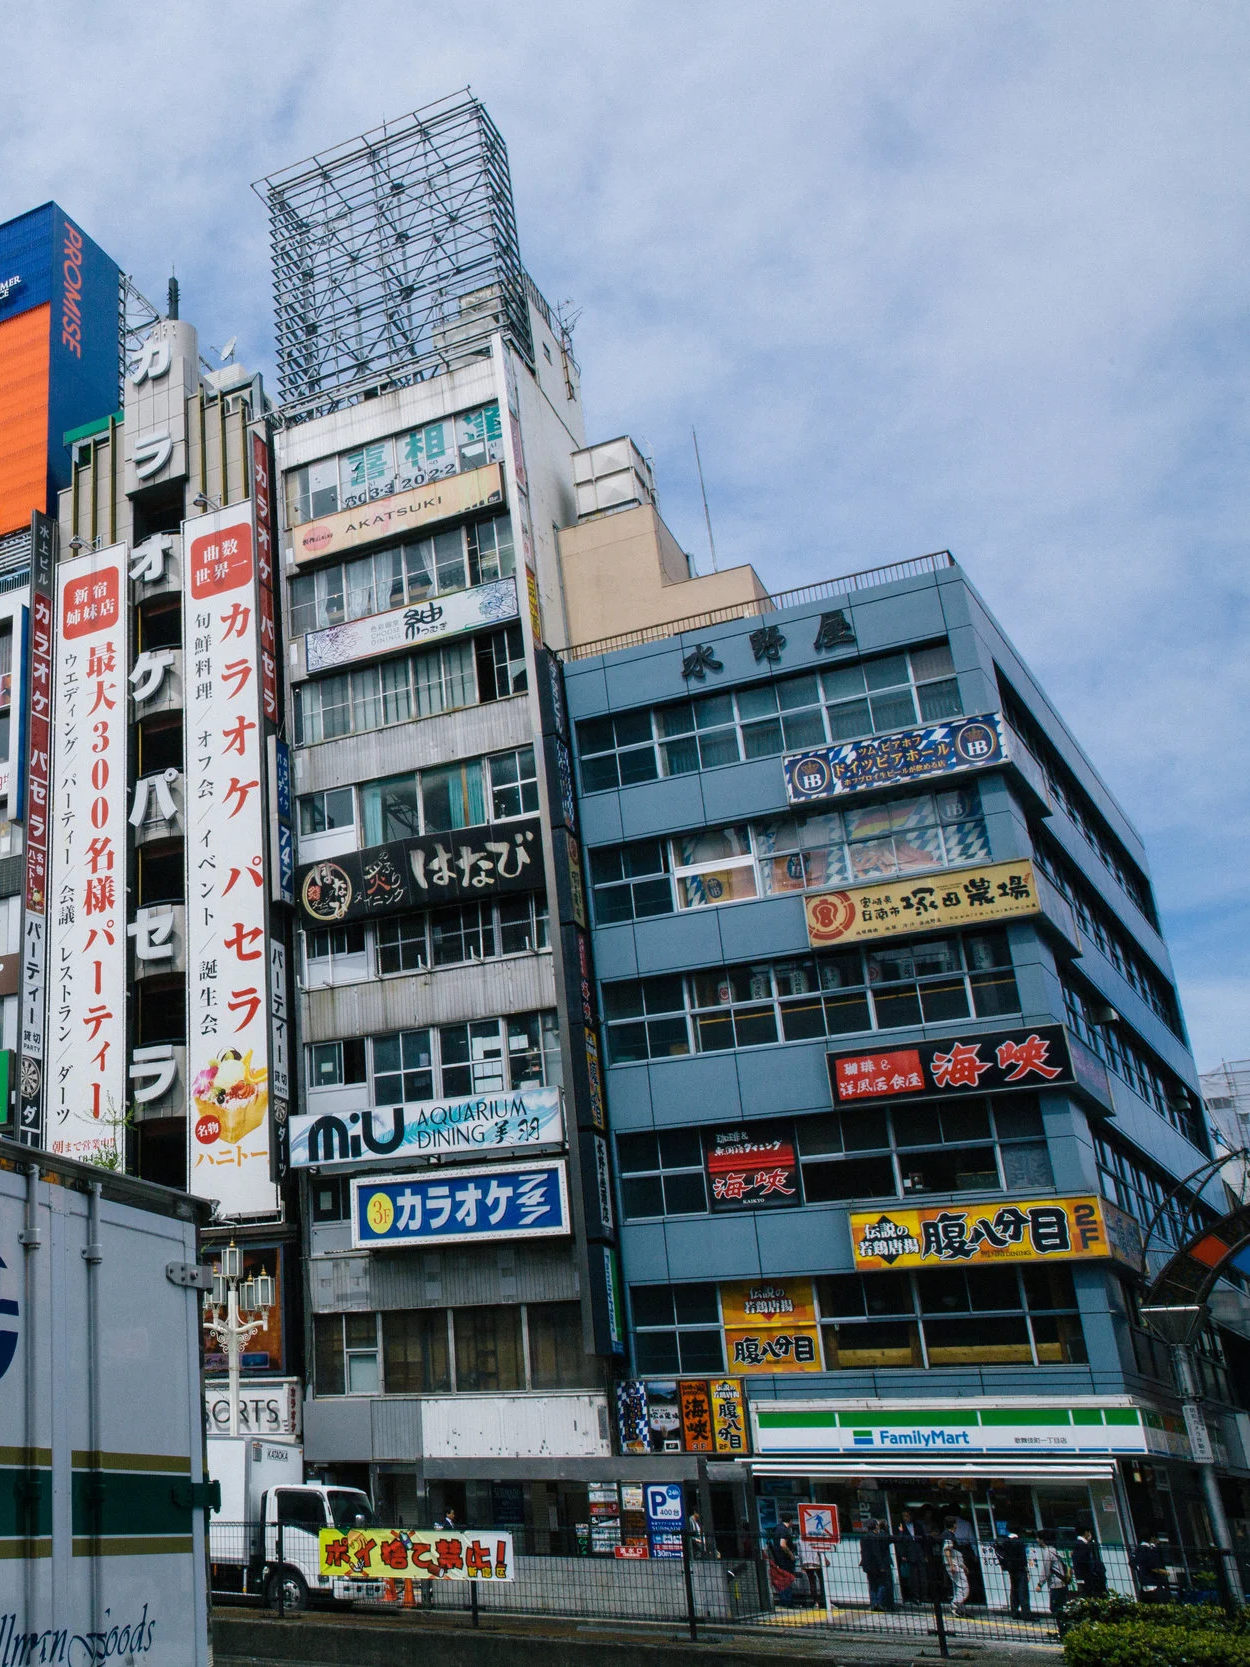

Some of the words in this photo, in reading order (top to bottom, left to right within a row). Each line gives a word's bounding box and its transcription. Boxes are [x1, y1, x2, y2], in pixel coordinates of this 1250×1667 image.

[61, 221, 84, 359] PROMISE
[345, 496, 443, 534] AKATSUKI
[38, 524, 51, 587] 水上ビル
[203, 540, 239, 564] 曲数
[195, 559, 249, 587] 世界一
[73, 580, 108, 604] 新宿
[67, 598, 115, 627] 姉妹店
[371, 627, 400, 640] CHOOSE
[371, 634, 401, 647] DINING
[834, 743, 950, 778] ドイツビアホール
[967, 740, 989, 757] HB
[803, 773, 822, 790] HB
[280, 825, 292, 888] 747
[410, 831, 534, 890] はなび
[900, 874, 1031, 917] 塚田農場
[861, 907, 901, 922] 日南市
[23, 1043, 41, 1053] PARTY
[930, 1034, 1063, 1088] 海峡
[417, 1097, 528, 1128] AQUARIUM
[197, 1121, 219, 1138] 名物
[417, 1124, 486, 1150] DINING
[193, 1144, 268, 1169] ハニトー
[713, 1168, 796, 1199] 海峡
[372, 1199, 391, 1226] 3F
[396, 1180, 515, 1232] カラオケ
[864, 1222, 909, 1238] 伝説の
[920, 1206, 1071, 1261] 腹八分目
[858, 1239, 920, 1258] 若鶏唐揚
[733, 1334, 815, 1366] 腹八分目
[879, 1430, 970, 1447] FamilyMart
[650, 1490, 667, 1517] P
